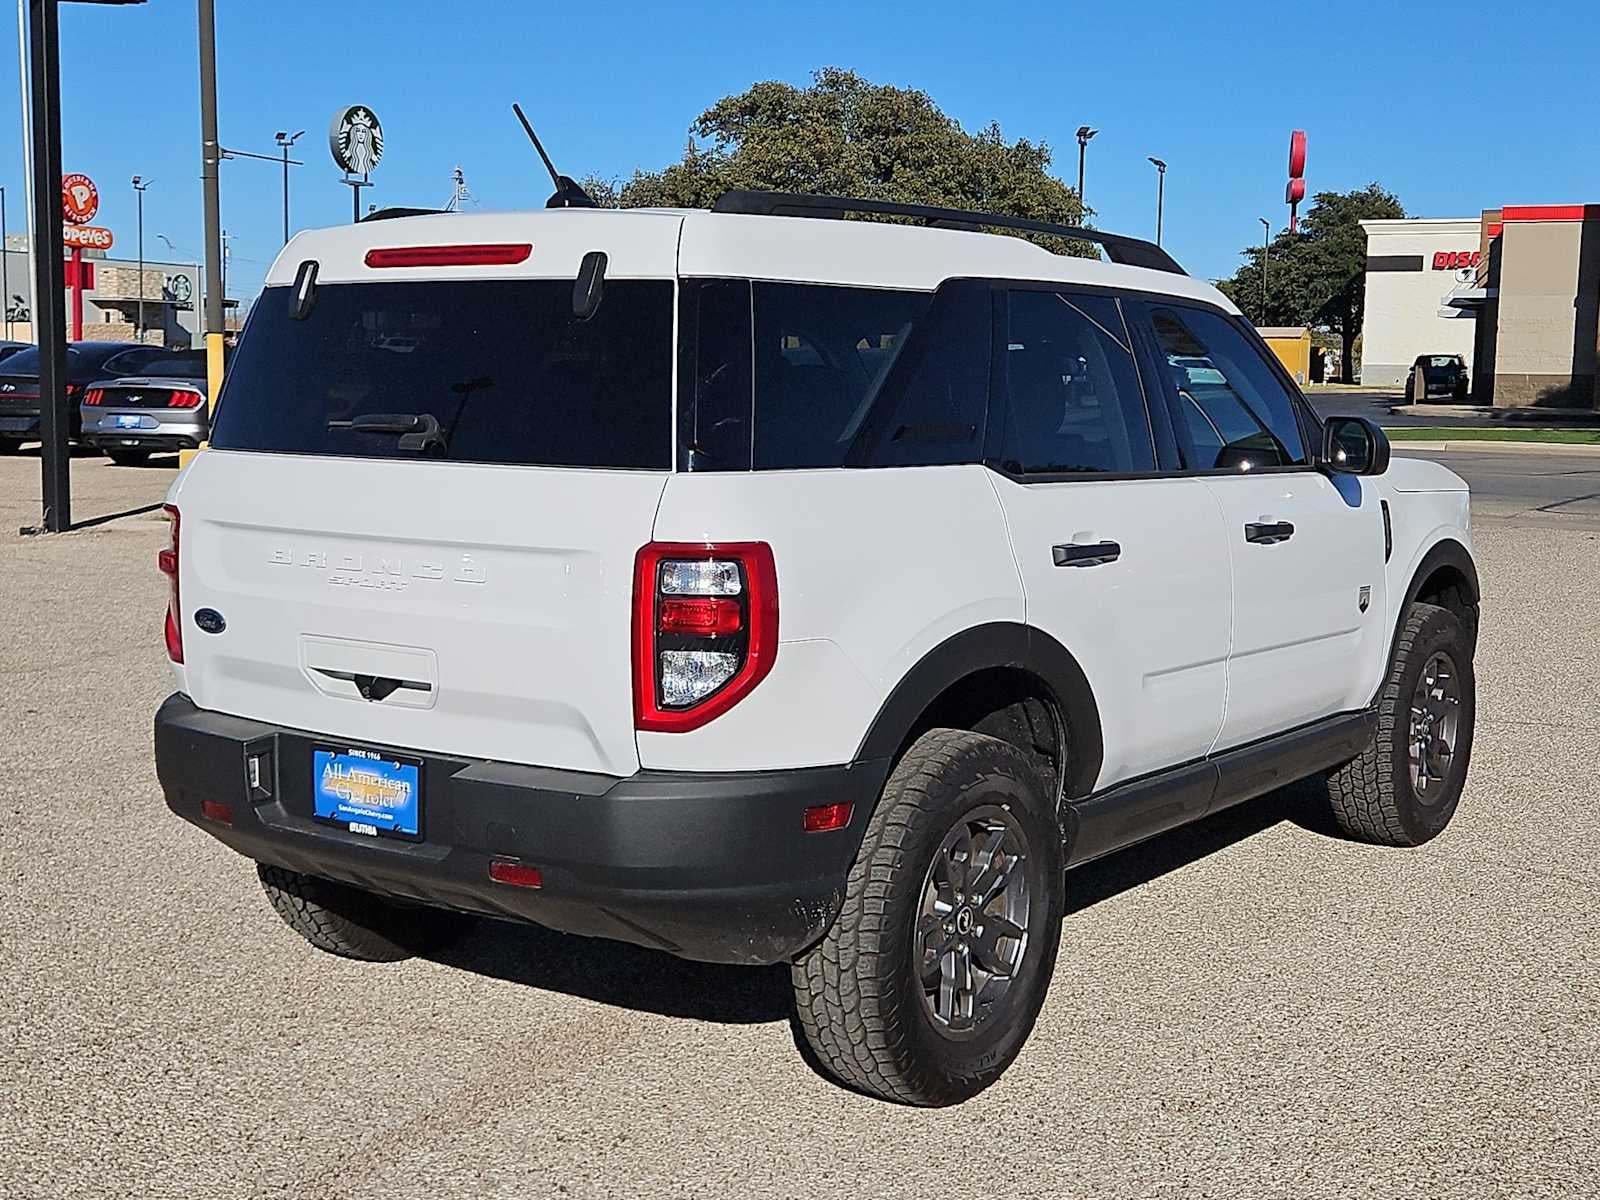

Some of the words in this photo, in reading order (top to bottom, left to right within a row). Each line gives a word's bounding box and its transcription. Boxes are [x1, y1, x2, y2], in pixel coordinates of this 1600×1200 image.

[70, 185, 91, 211] P
[268, 548, 486, 583] BRONCO
[328, 575, 408, 591] SPORT
[348, 749, 366, 759] SINCE
[322, 763, 343, 779] All
[346, 768, 411, 792] American
